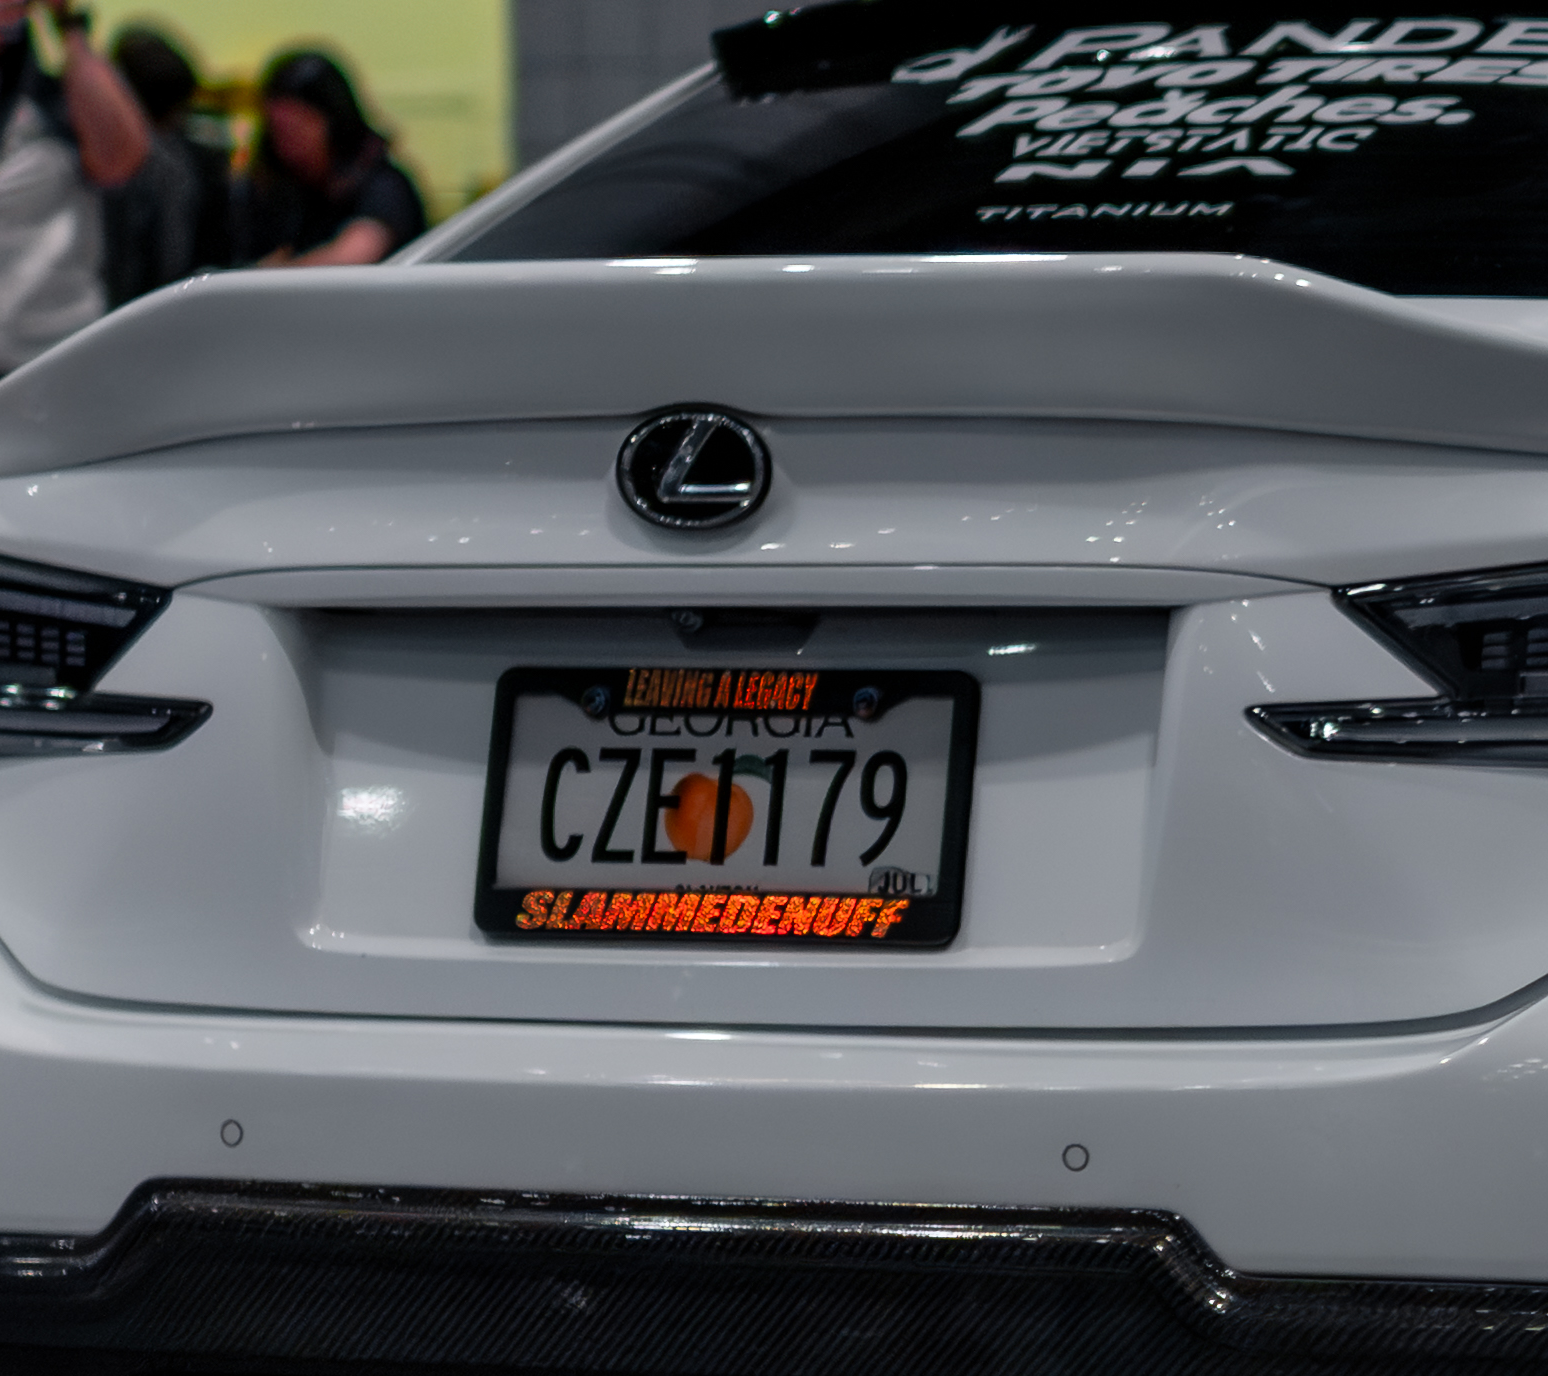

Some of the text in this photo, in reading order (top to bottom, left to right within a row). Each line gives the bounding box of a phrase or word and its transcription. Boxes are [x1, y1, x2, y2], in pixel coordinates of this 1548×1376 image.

[946, 57, 1256, 104] TOYO
[1013, 126, 1377, 159] VIETSTATIC
[974, 200, 1235, 222] TITANIUM
[622, 669, 820, 712] LEAVING A LEGACY
[540, 746, 908, 867] CZE1179
[515, 889, 911, 939] SLAMMEDENUFF
